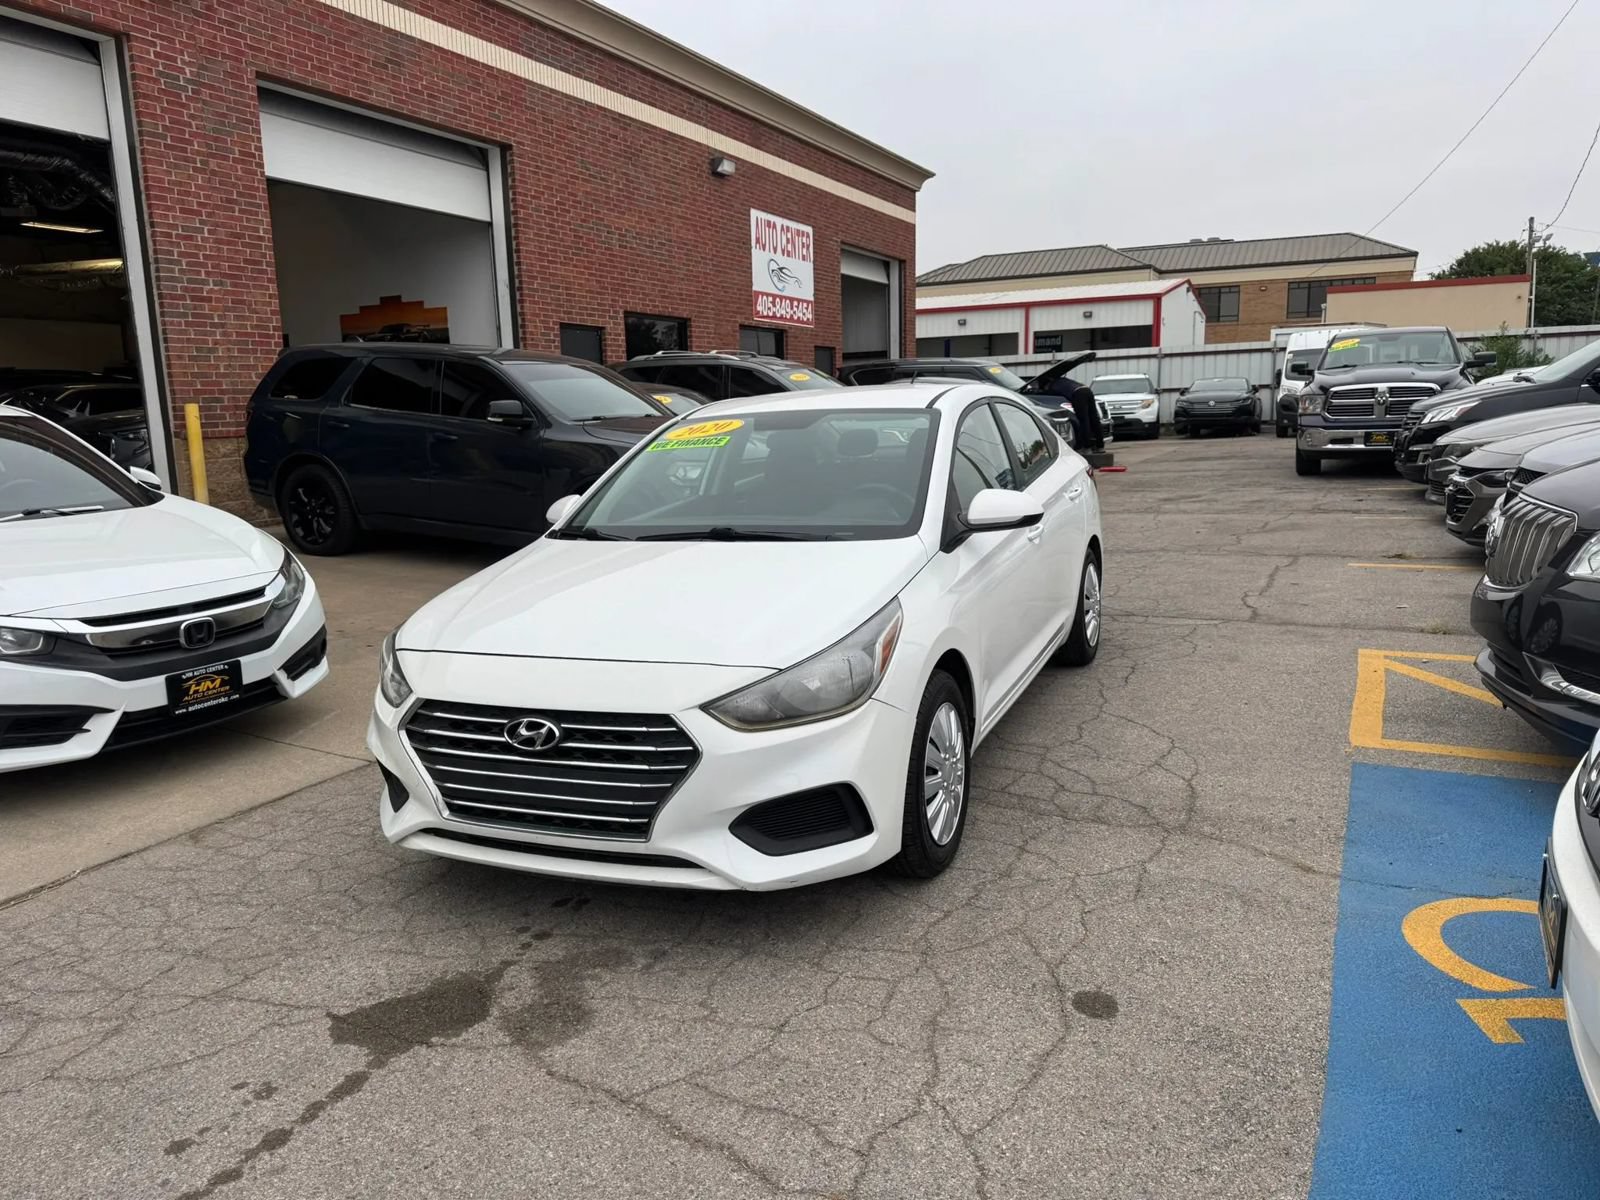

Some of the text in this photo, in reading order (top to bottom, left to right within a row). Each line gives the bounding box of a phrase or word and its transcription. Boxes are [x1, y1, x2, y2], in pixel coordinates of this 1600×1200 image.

[755, 216, 812, 262] AUTO CENTER
[756, 294, 812, 321] 405-849-5454
[674, 421, 734, 438] 2020
[651, 437, 727, 450] WE FINANCE
[194, 668, 206, 676] AUTO
[206, 664, 224, 673] CENTER
[182, 693, 203, 701] AUTO
[203, 685, 230, 696] CENTER
[188, 678, 222, 695] HM
